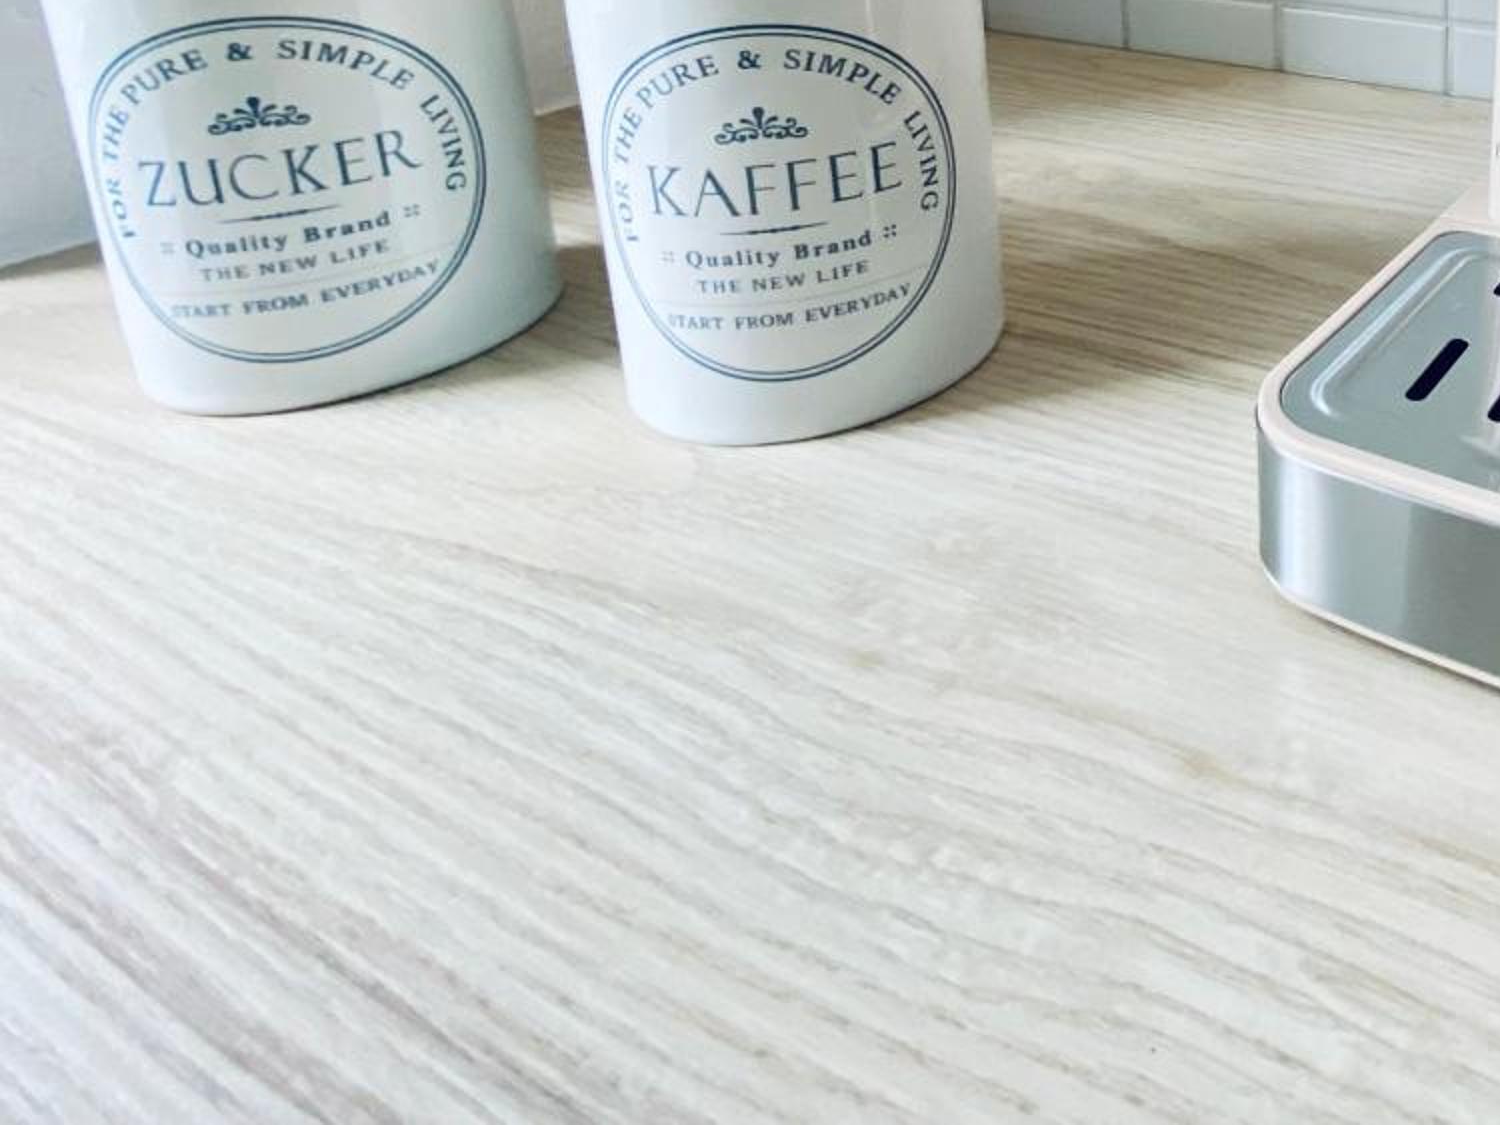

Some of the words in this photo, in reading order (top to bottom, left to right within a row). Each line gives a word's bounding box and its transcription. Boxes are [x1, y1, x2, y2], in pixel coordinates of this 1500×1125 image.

[121, 49, 208, 106] PURE
[227, 42, 253, 62] &
[277, 39, 415, 90] SIMPLE
[103, 105, 129, 161] THE
[420, 94, 467, 192] LIVING
[614, 106, 643, 164] THE
[636, 54, 720, 108] PURE
[737, 49, 762, 70] &
[783, 48, 902, 105] SIMPLE
[903, 110, 940, 212] LIVING
[138, 130, 423, 209] ZUCKER
[647, 141, 903, 218] KAFFEE
[107, 178, 136, 238] FOR
[185, 234, 288, 259] Quality
[303, 210, 391, 244] Brand
[200, 267, 251, 282] THE
[259, 255, 318, 276] NEW
[330, 239, 390, 265] LIFE
[686, 249, 780, 269] Quality
[794, 229, 872, 261] Brand
[698, 279, 741, 294] THE
[752, 272, 806, 292] NEW
[816, 259, 870, 284] LIFE
[243, 292, 310, 315] FROM
[320, 259, 440, 303] EVERYDAY
[735, 311, 794, 330] FROM
[805, 283, 911, 323] EVERYDAY
